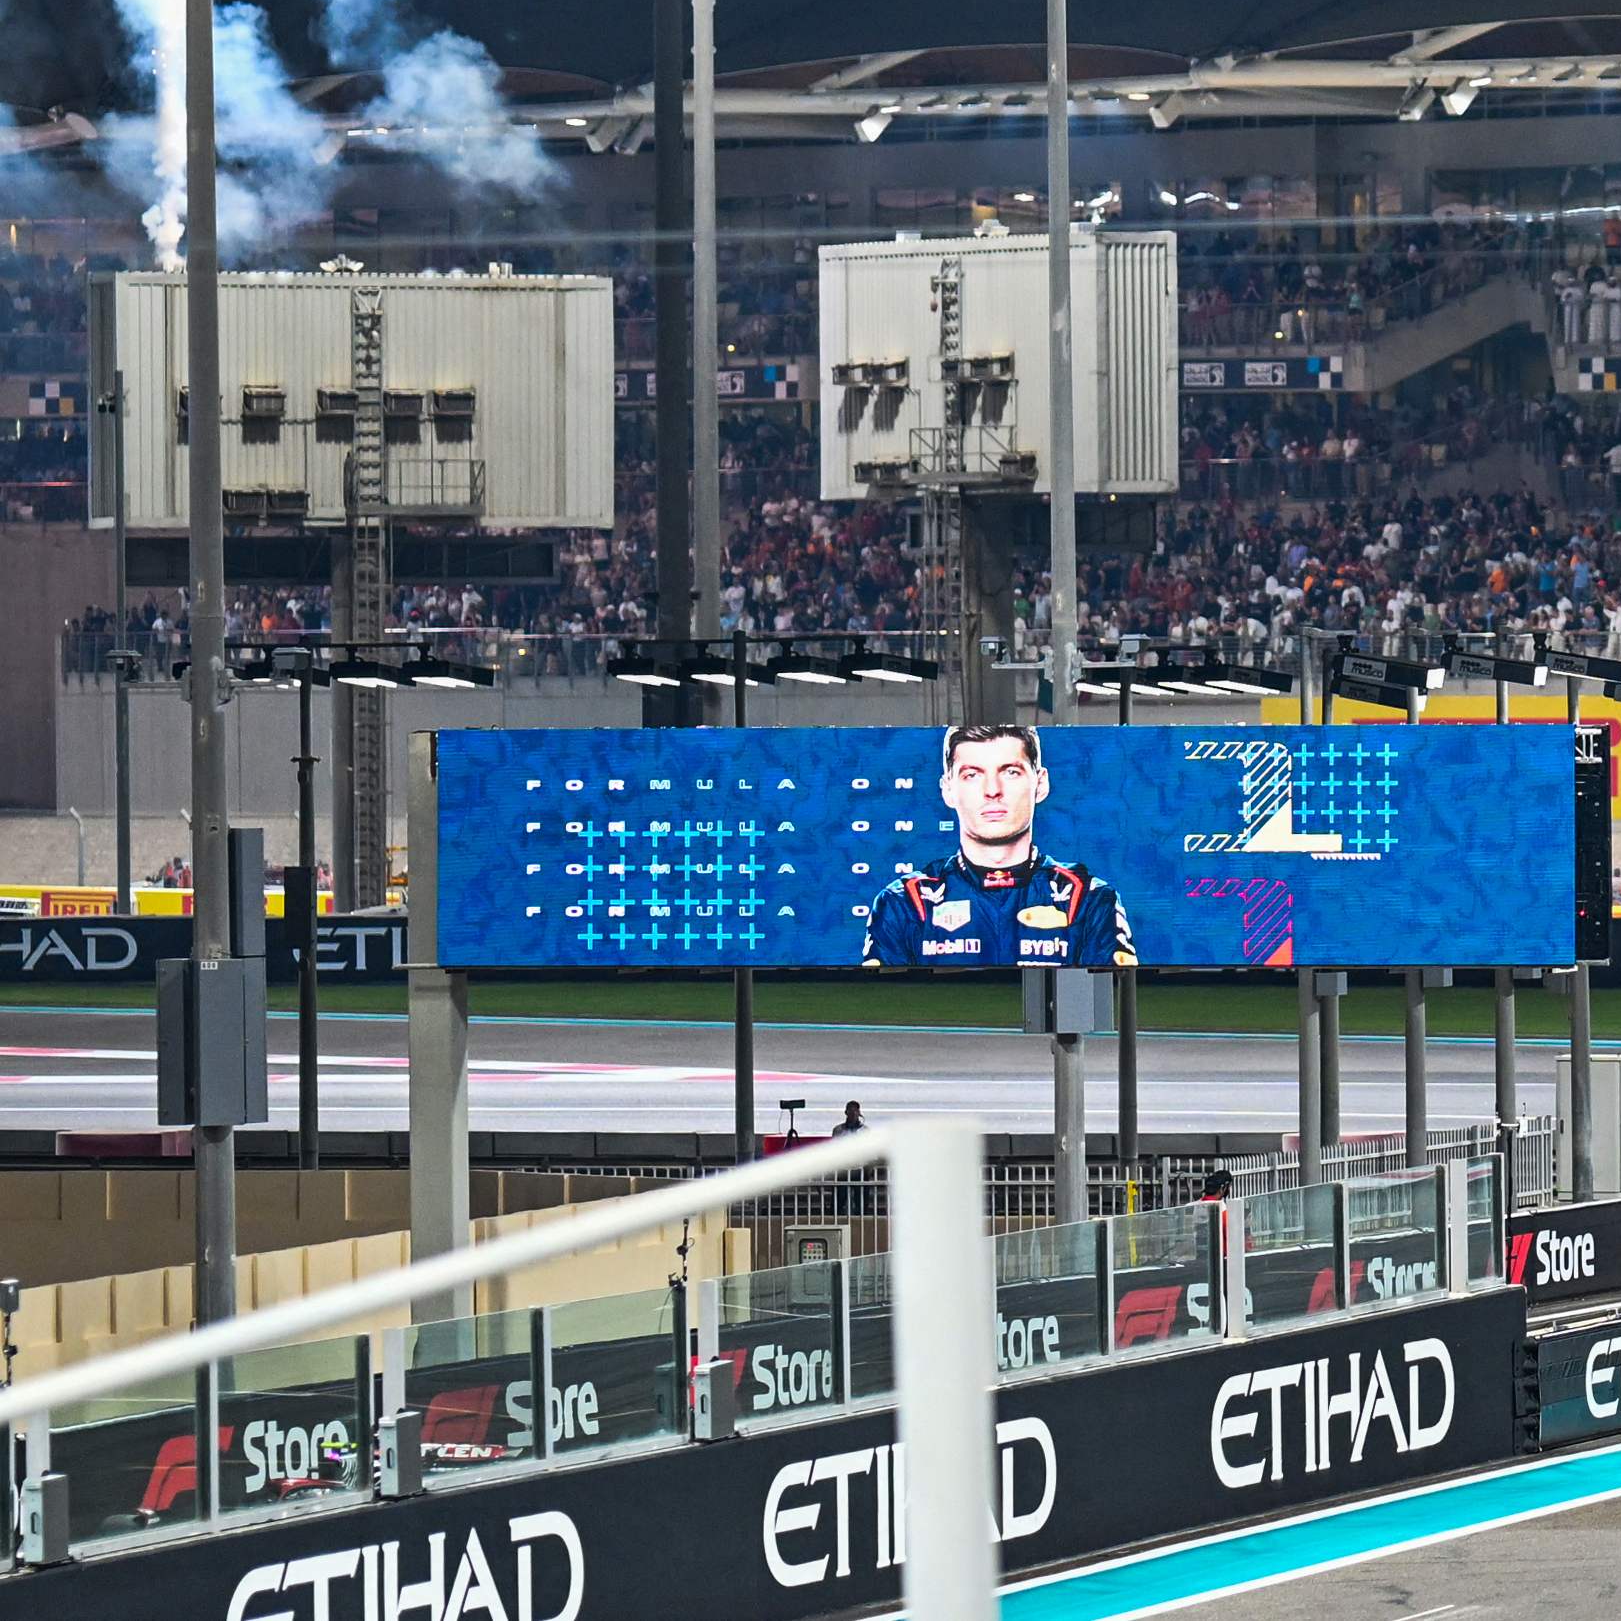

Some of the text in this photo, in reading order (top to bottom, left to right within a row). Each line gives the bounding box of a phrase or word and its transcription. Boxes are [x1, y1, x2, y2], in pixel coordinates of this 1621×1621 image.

[1351, 665, 1384, 679] musco
[526, 777, 914, 791] FORMULA ON
[526, 820, 954, 833] FORMULA ONE
[526, 862, 914, 875] FORMULA ON
[526, 905, 796, 917] FORMULA
[0, 927, 138, 971] HAD
[292, 927, 407, 971] ETI
[922, 939, 965, 956] Mobil
[1535, 1229, 1595, 1286] Store
[996, 1315, 1060, 1369] tore
[752, 1343, 832, 1410] Store
[505, 1380, 599, 1448] Sore
[1211, 1337, 1455, 1489] ETIHAD
[763, 1416, 1057, 1586] ETID
